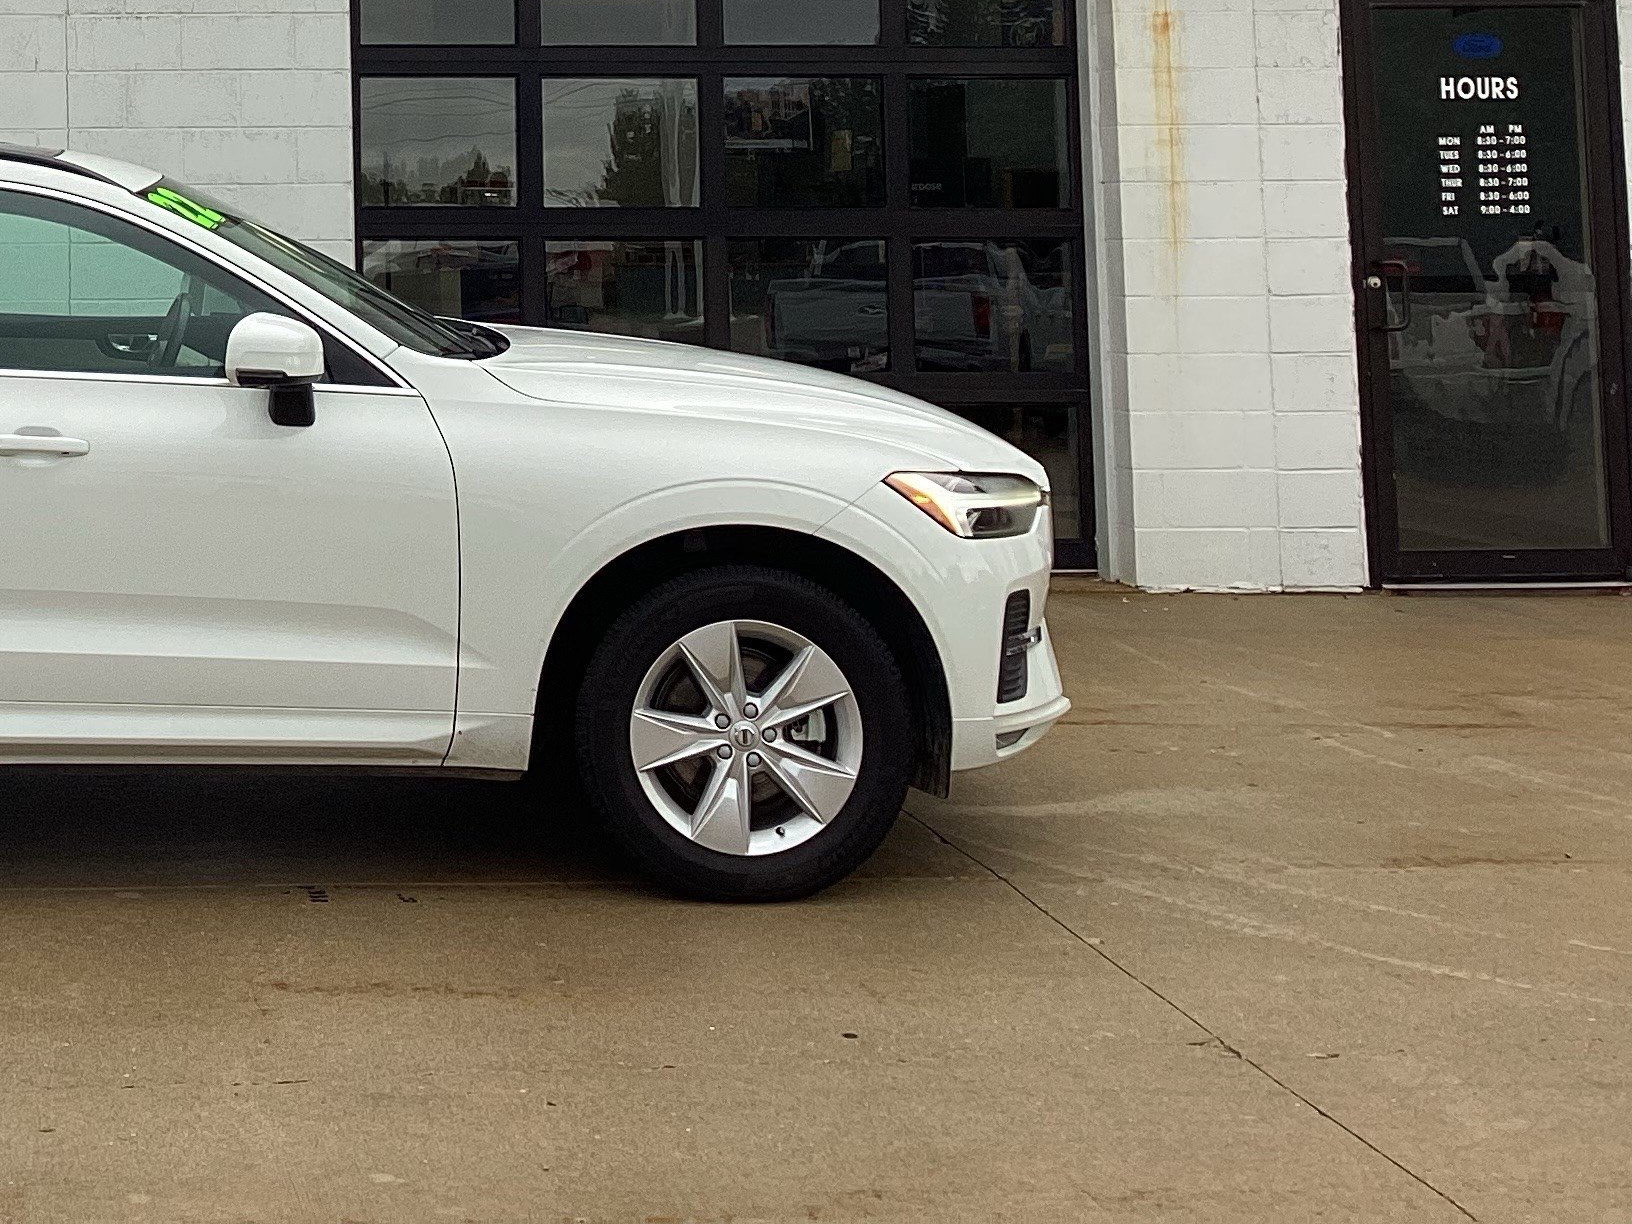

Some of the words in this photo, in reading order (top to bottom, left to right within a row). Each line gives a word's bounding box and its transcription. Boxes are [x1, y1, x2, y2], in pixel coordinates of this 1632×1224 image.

[1440, 76, 1519, 100] HOURS
[1479, 124, 1495, 134] AM
[1508, 124, 1523, 134] PM
[1438, 136, 1461, 146] MON
[1440, 164, 1461, 173] WED
[1441, 192, 1456, 201] FRI
[1442, 206, 1459, 215] SAT
